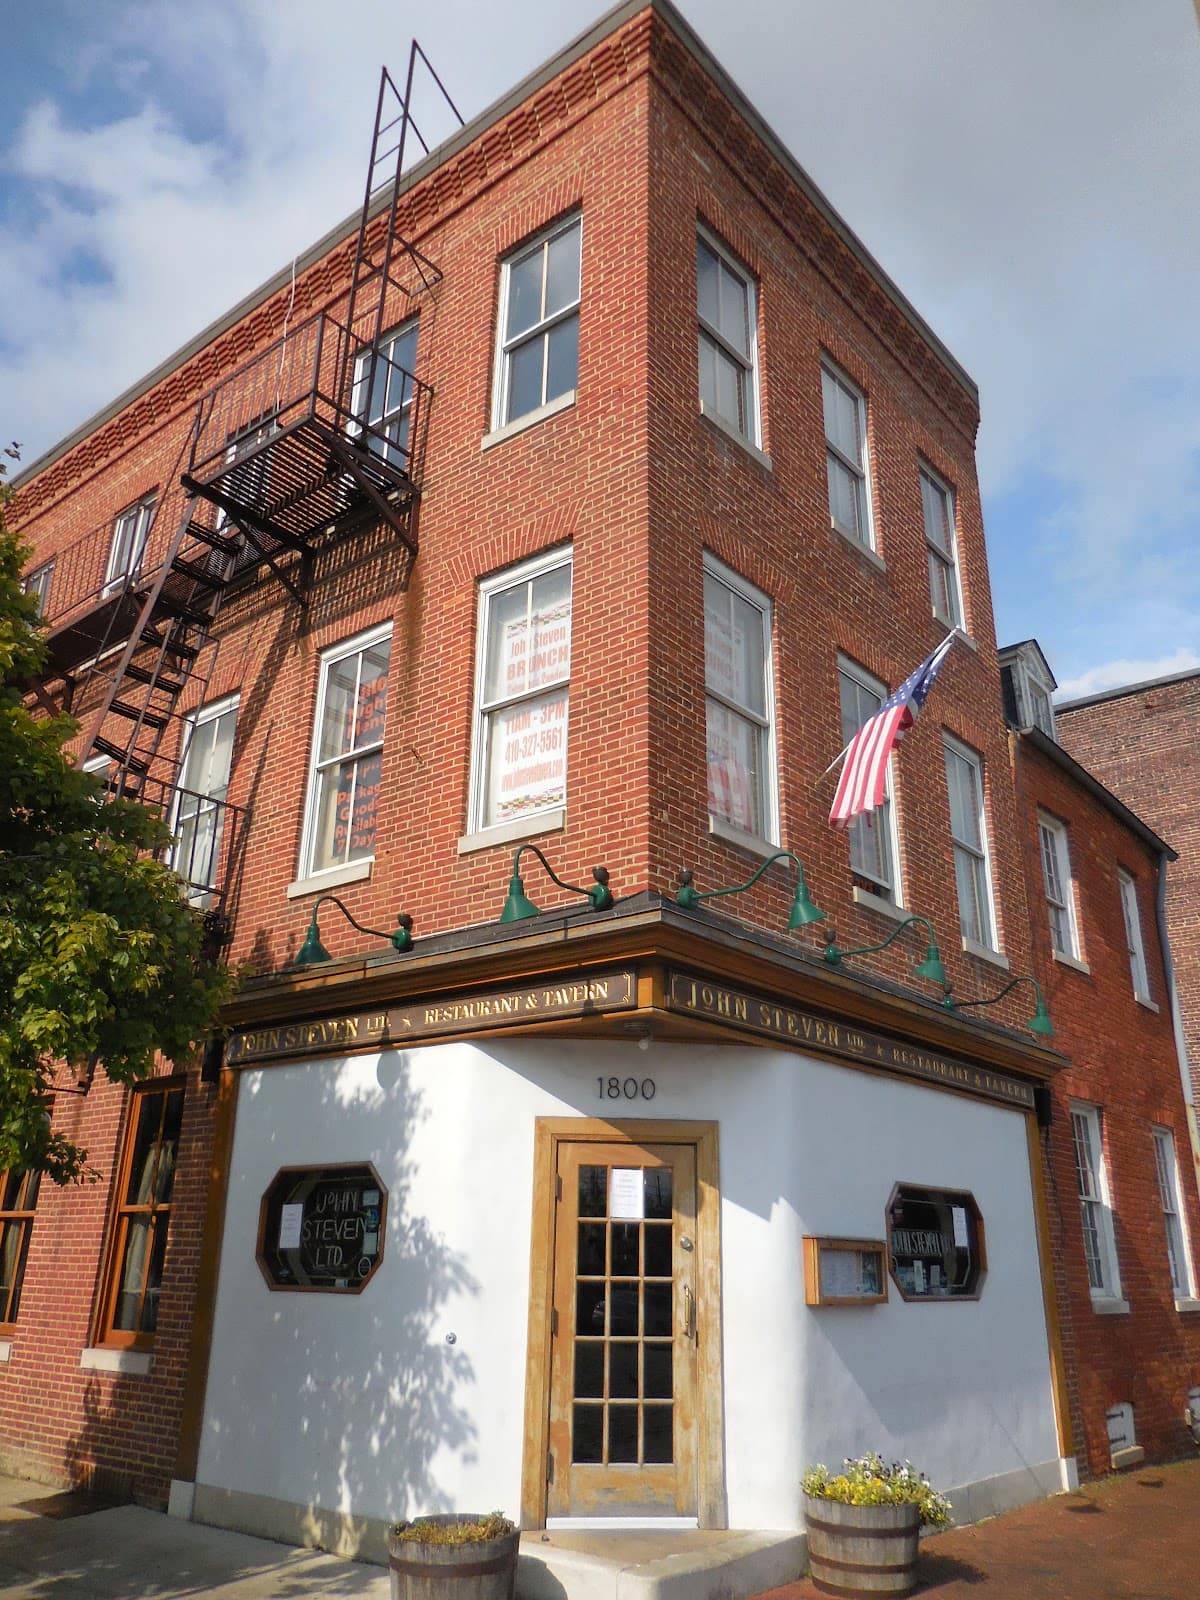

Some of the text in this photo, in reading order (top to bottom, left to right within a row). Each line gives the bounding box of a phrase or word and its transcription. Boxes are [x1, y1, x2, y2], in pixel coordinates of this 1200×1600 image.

[534, 626, 566, 649] Steven
[507, 645, 568, 681] BRUNCH
[540, 702, 565, 724] 3PM
[238, 1030, 280, 1057] JOHN
[285, 1017, 360, 1049] STEVEN
[423, 995, 522, 1024] RESTAURANT
[525, 994, 538, 1009] &
[541, 981, 609, 1007] TAVERN
[687, 982, 748, 1021] JOHN
[759, 1003, 840, 1047] STEVEN
[892, 1048, 970, 1082] RESTAURANT
[986, 1075, 1028, 1099] TAVERN
[597, 1077, 656, 1100] 1800
[316, 1191, 357, 1213] JOHN
[303, 1217, 367, 1240] STEVEN
[316, 1245, 343, 1267] LTD
